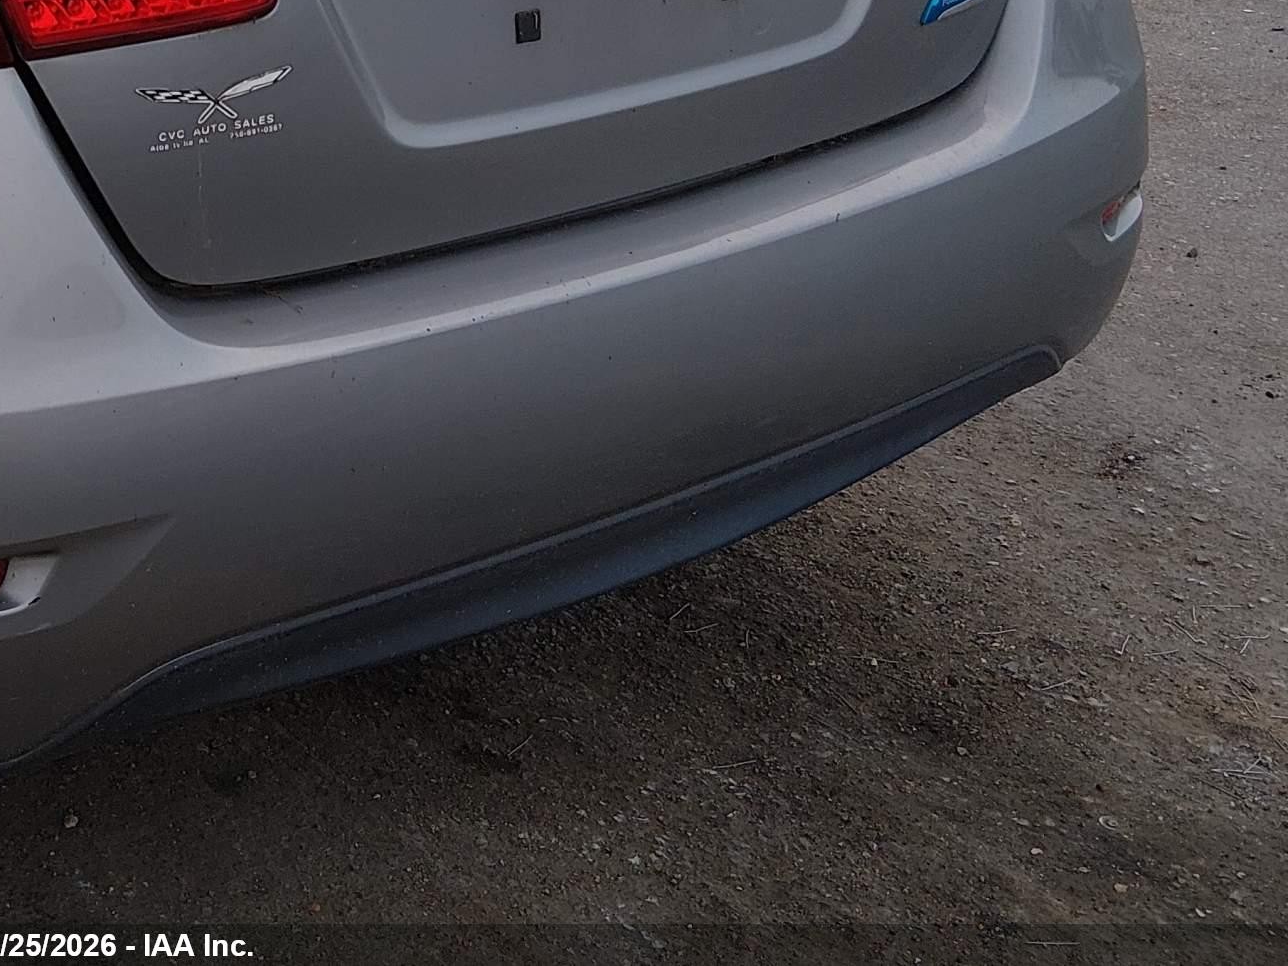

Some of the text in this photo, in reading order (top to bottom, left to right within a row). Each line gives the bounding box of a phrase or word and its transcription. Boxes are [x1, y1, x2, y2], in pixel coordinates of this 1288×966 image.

[158, 114, 275, 142] CVC AUTO SALES
